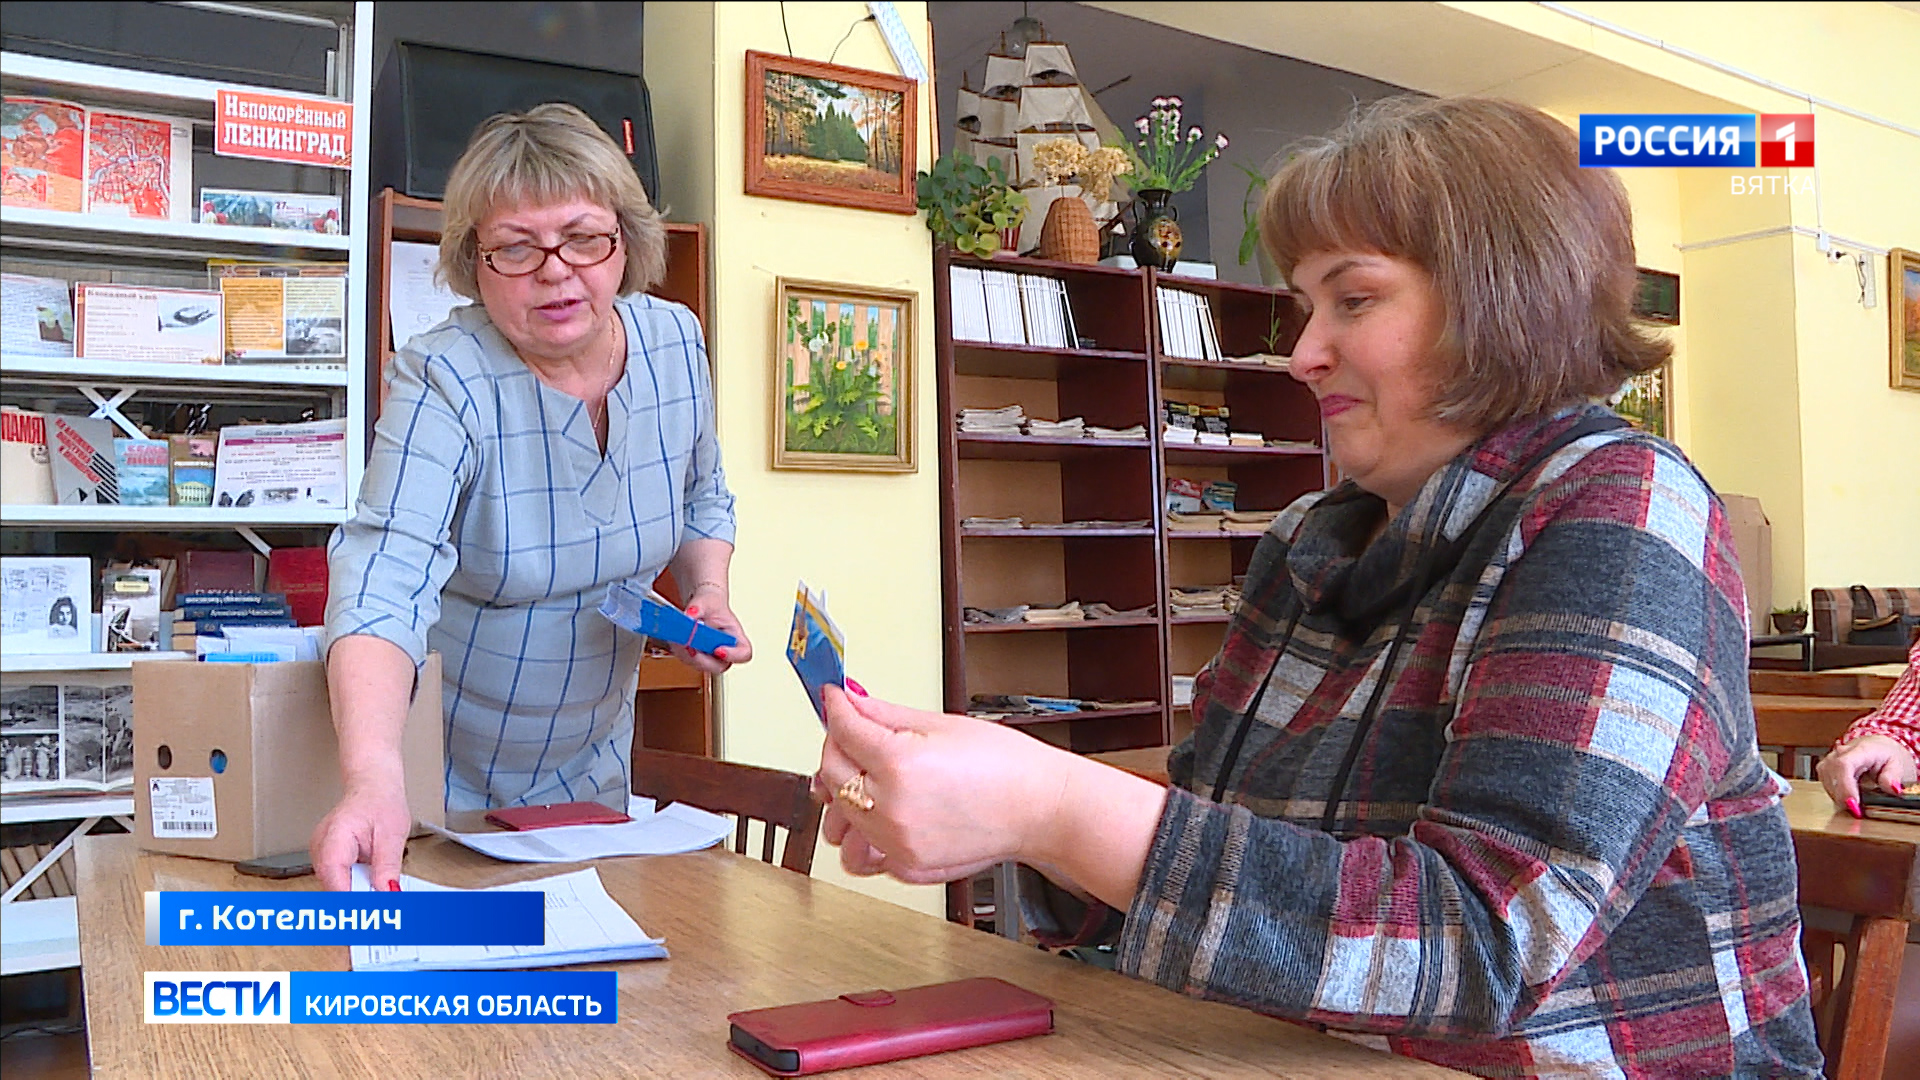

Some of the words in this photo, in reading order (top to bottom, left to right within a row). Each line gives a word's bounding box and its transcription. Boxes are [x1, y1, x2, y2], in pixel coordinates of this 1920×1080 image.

[224, 94, 347, 130] Непокорённый
[223, 121, 347, 160] ЛЕНИНГРАД
[1, 413, 47, 445] ПАМЯТ
